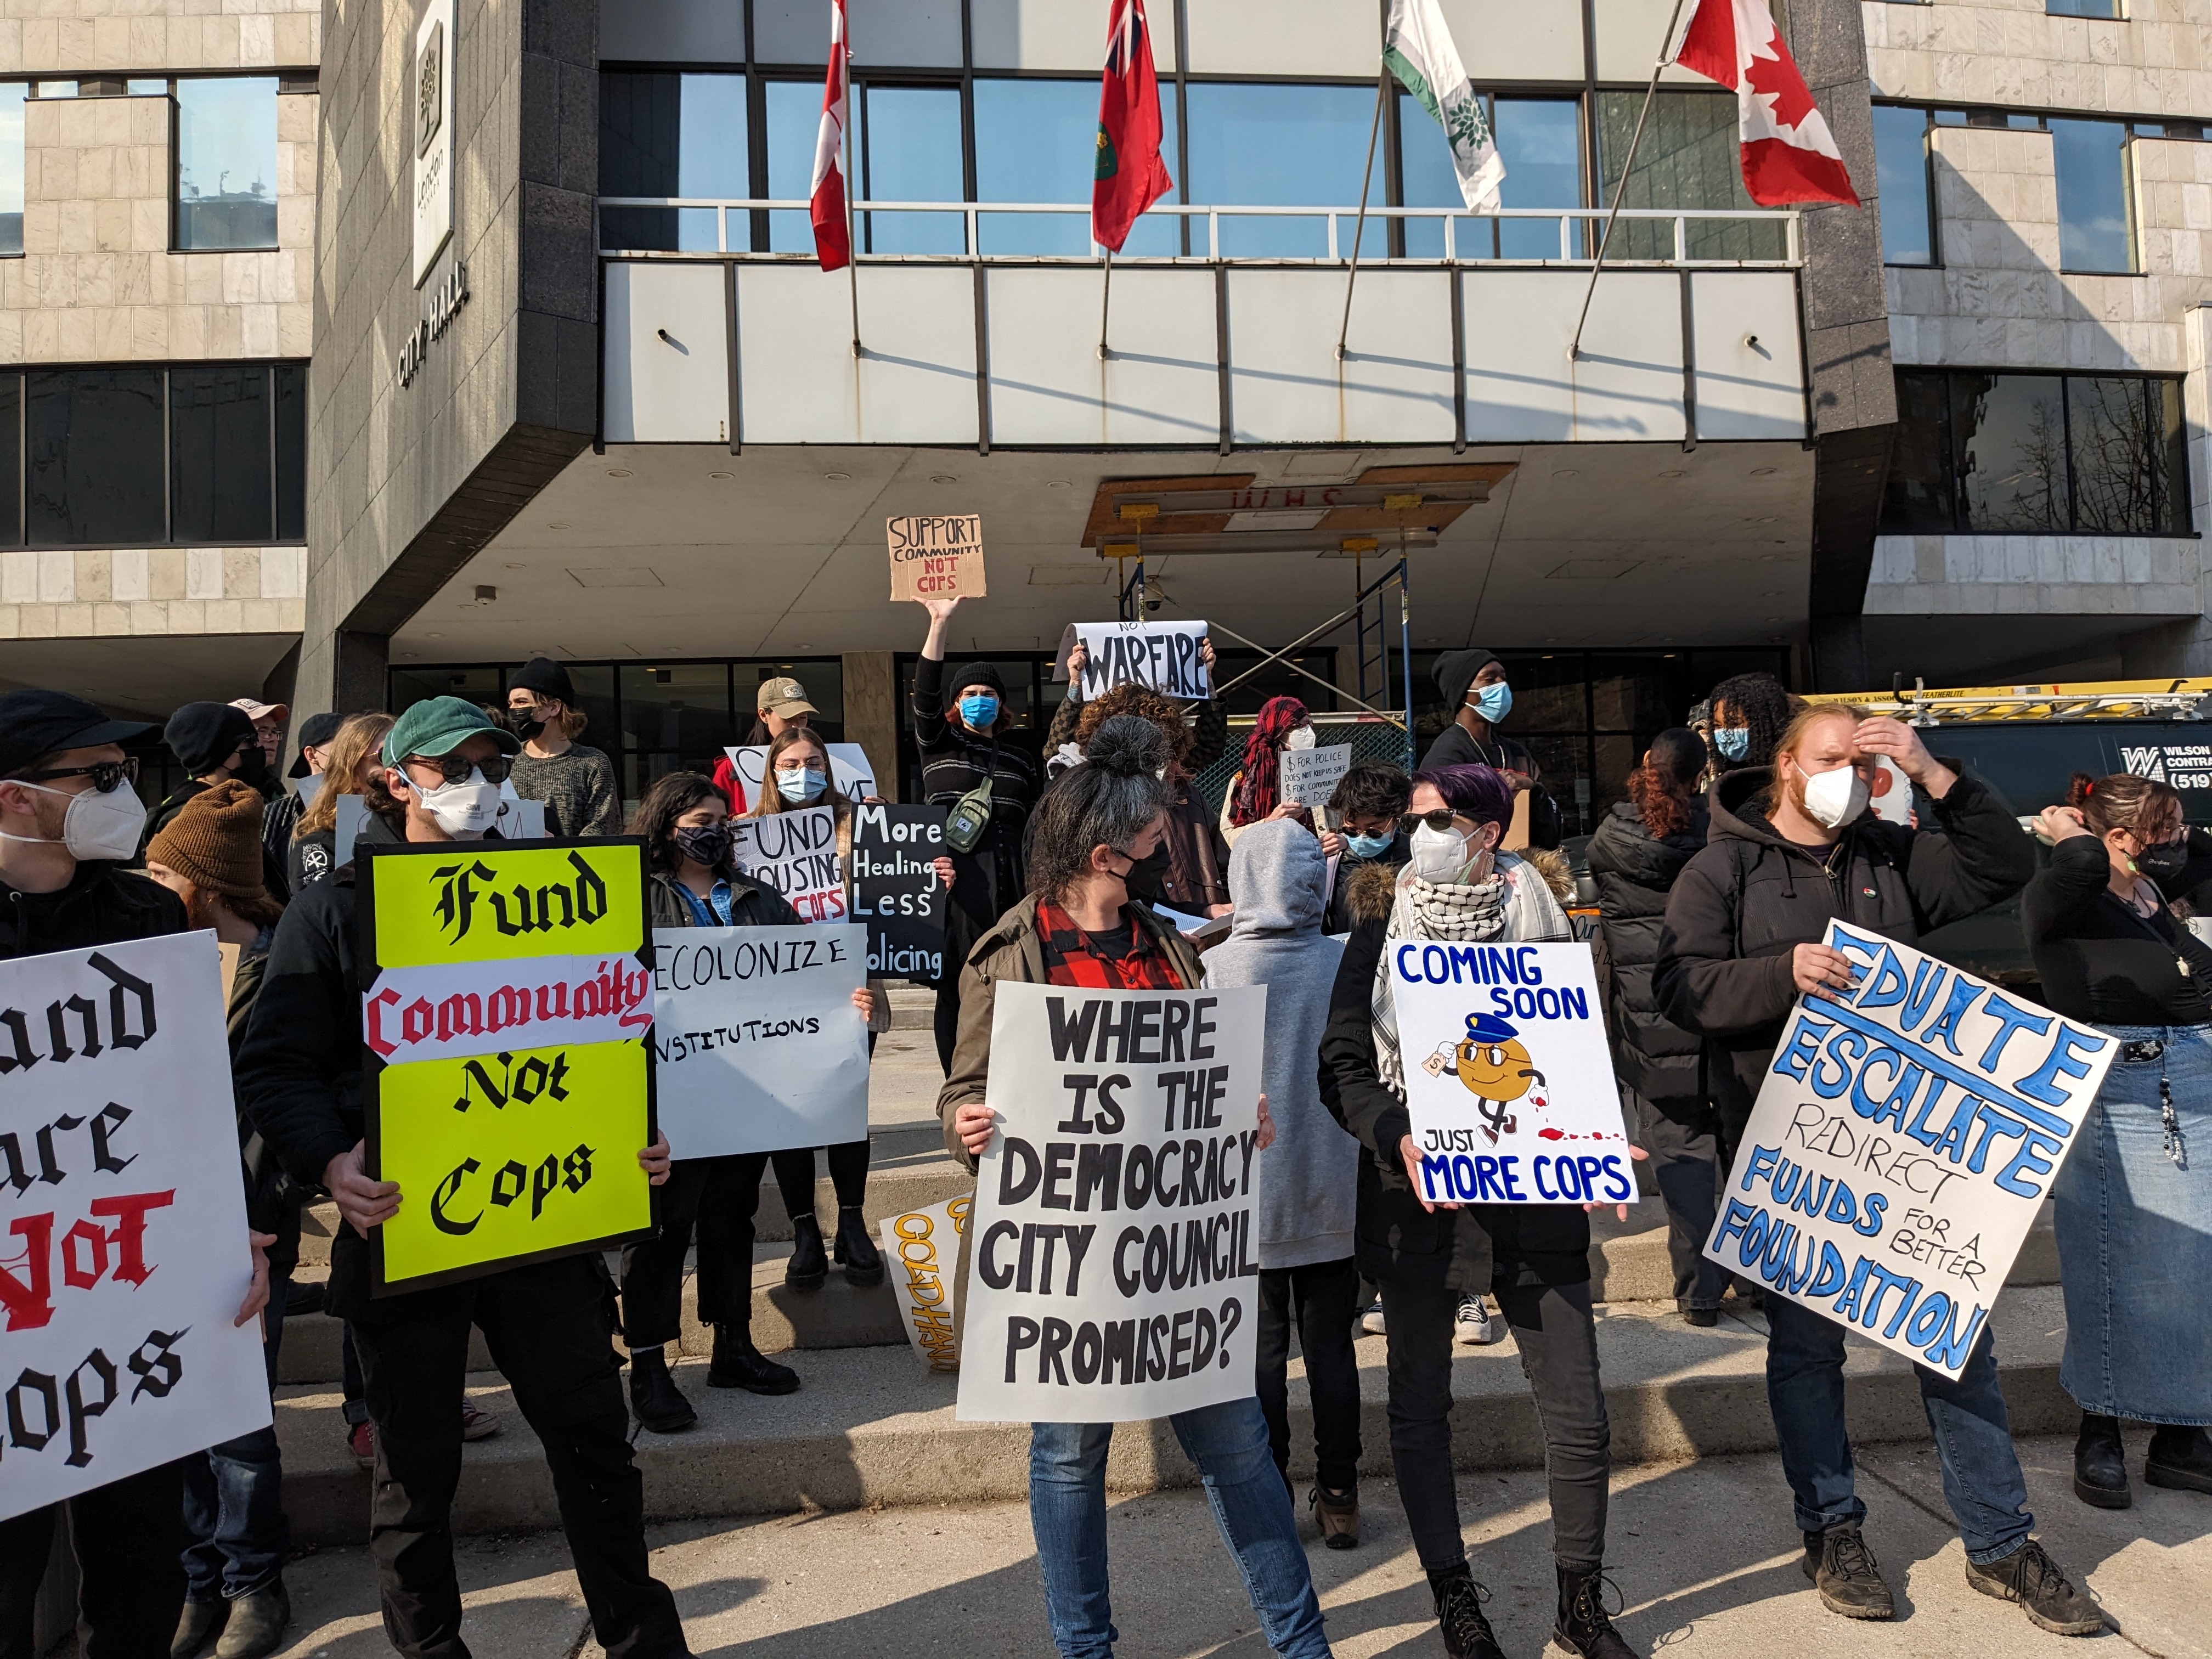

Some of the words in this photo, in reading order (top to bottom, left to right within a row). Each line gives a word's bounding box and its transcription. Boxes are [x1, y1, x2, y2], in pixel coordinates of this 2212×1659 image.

[417, 148, 443, 209] London
[398, 319, 426, 387] CITY
[430, 261, 465, 341] HALL
[889, 517, 979, 549] SUPPORT
[894, 544, 981, 562] COMMUNITY
[917, 575, 957, 593] COPS
[924, 556, 959, 574] NOT
[1118, 621, 1150, 631] NOT
[1079, 632, 1207, 697] WARFARE
[1922, 690, 1965, 698] FEATHERLITE
[1284, 773, 1301, 782] DOES
[1302, 770, 1313, 780] NOT
[1313, 769, 1326, 777] KEEP
[1334, 765, 1347, 774] SAFE
[1297, 757, 1312, 768] FOR
[1316, 751, 1342, 764] POLICE
[2162, 746, 2210, 756] WILSON
[1293, 783, 1305, 793] FOR
[2170, 772, 2212, 789] (519
[727, 812, 833, 860] FUND
[854, 805, 942, 843] More
[750, 852, 842, 896] OUSING
[853, 849, 936, 893] Healing
[428, 850, 609, 946] Fund
[792, 887, 845, 924] COPS
[854, 883, 931, 916] Less
[1575, 915, 1599, 939] Our
[652, 939, 847, 991] ECOLONIZE
[866, 932, 943, 980] olicing
[1397, 944, 1543, 985] COMING
[366, 957, 654, 1058] Community
[1490, 986, 1589, 1020] SOON
[1817, 924, 2108, 1107] EDUATE
[655, 1017, 820, 1064] NSTITUTIONS
[1045, 996, 1218, 1064] WHERE
[453, 1051, 571, 1114] Not
[1057, 1073, 1131, 1135] IS
[1158, 1065, 1229, 1132] THE
[1773, 1015, 2063, 1199] ESCALATE
[1424, 1128, 1475, 1152] JUST
[1785, 1103, 1968, 1204] REDIRECT
[430, 1142, 597, 1236] Cops
[998, 1129, 1258, 1212] DEMOCRACY
[1421, 1154, 1528, 1201] MORE
[1533, 1154, 1632, 1201] COPS
[1741, 1144, 1889, 1238] FUNDS
[978, 1218, 1097, 1296] CITY
[1113, 1208, 1259, 1299] COUNCIL
[1903, 1207, 1951, 1243] FOR
[1966, 1233, 1982, 1260] A
[1712, 1197, 1989, 1372] FOUNDATION
[1889, 1229, 1987, 1292] BETTER
[1004, 1296, 1242, 1386] PROMISED?
[0, 1324, 194, 1468] ops
